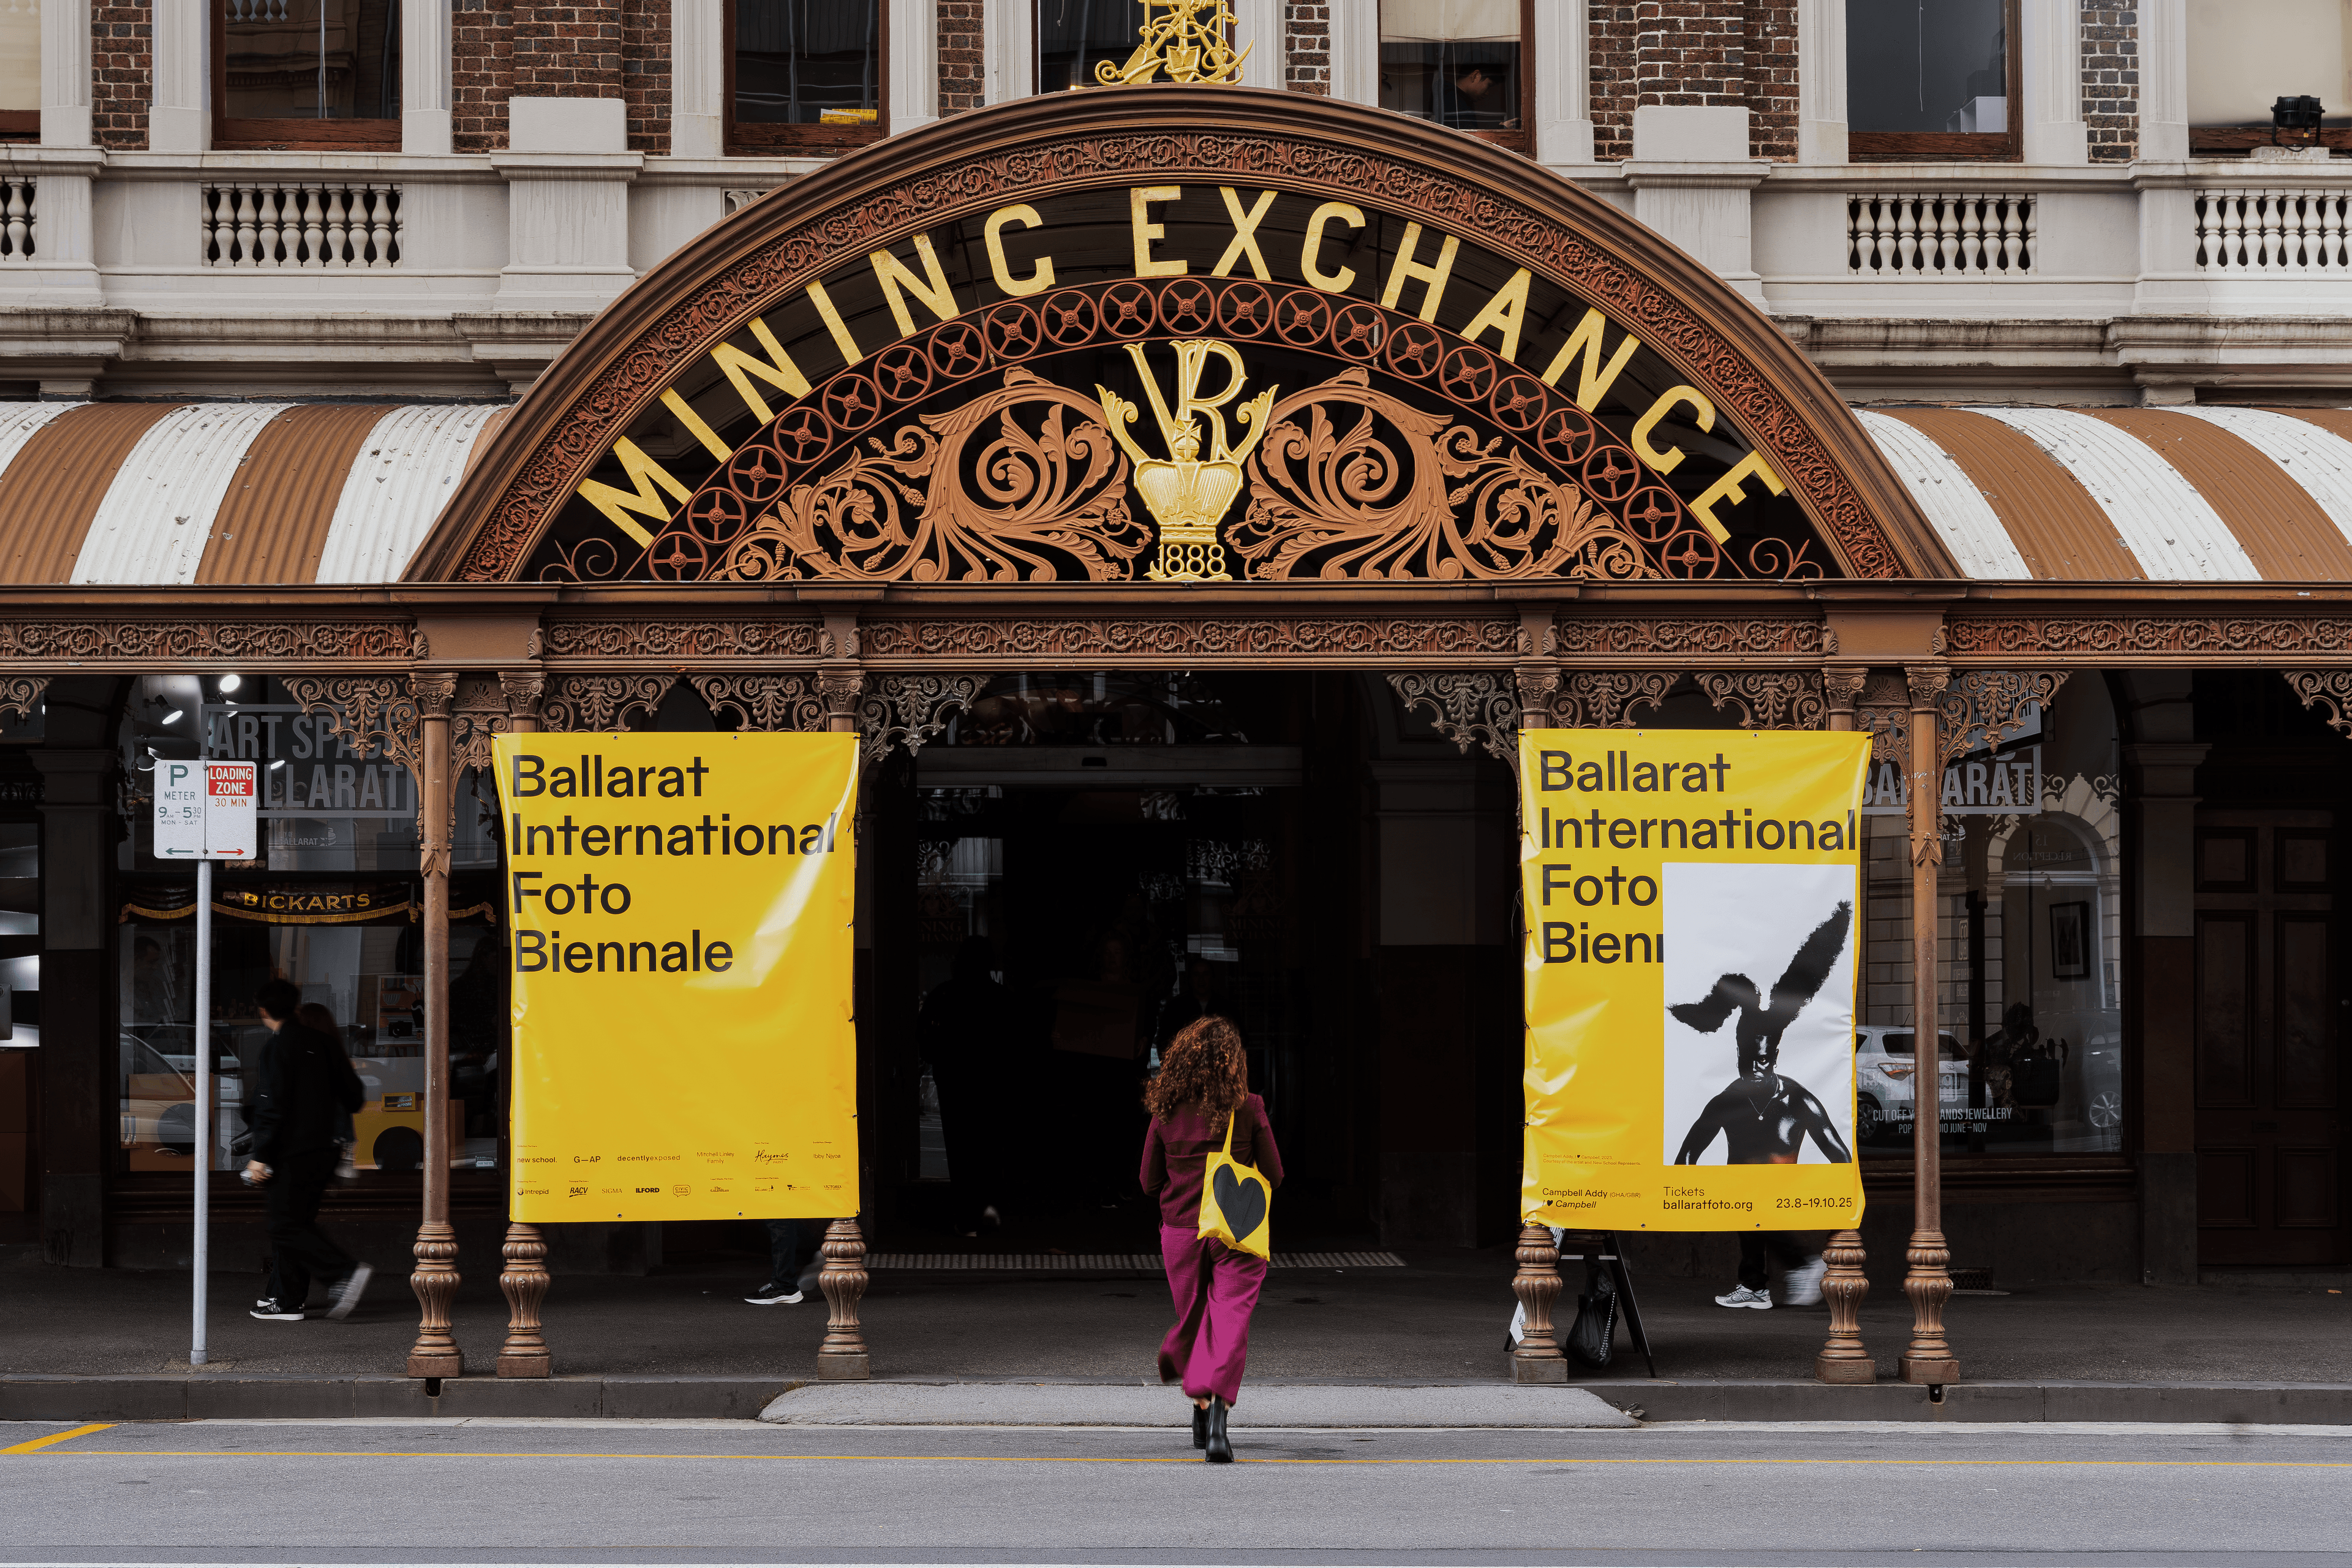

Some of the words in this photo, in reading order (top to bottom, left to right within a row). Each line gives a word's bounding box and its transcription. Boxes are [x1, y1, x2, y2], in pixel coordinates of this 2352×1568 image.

[578, 204, 1055, 548] MINING
[1130, 186, 1787, 545] EXCHANGE
[1158, 543, 1226, 576] 1888
[213, 715, 282, 759] ART
[170, 765, 189, 786] P
[210, 767, 252, 780] LOADING
[512, 755, 709, 798] Ballarat
[1540, 750, 1731, 793] Ballarat
[1861, 763, 2032, 805] AARAT
[164, 791, 195, 801] METER
[216, 782, 246, 794] ZONE
[256, 764, 404, 808] LLARAT
[215, 798, 226, 807] 30
[231, 798, 247, 807] MIN
[512, 812, 837, 856] International
[1540, 807, 1856, 851] International
[512, 872, 632, 915] Foto
[1542, 864, 1658, 907] Foto
[515, 929, 733, 973] Biennale
[1873, 1109, 1889, 1121] CUT
[1891, 1109, 1907, 1121] OFF
[1939, 1109, 1963, 1120] ANDS
[1964, 1107, 2013, 1120] JEWELLERY
[1899, 1124, 1912, 1134] POP
[1950, 1123, 1966, 1133] JUNE
[1973, 1123, 1987, 1133] NOV
[754, 1150, 789, 1165] Haymes
[1542, 1188, 1583, 1198] Campbell
[1585, 1189, 1608, 1199] Addy
[1556, 1200, 1597, 1210] Campbell
[1663, 1186, 1705, 1197] Tickets
[1663, 1199, 1753, 1212] ballaratfoto.org
